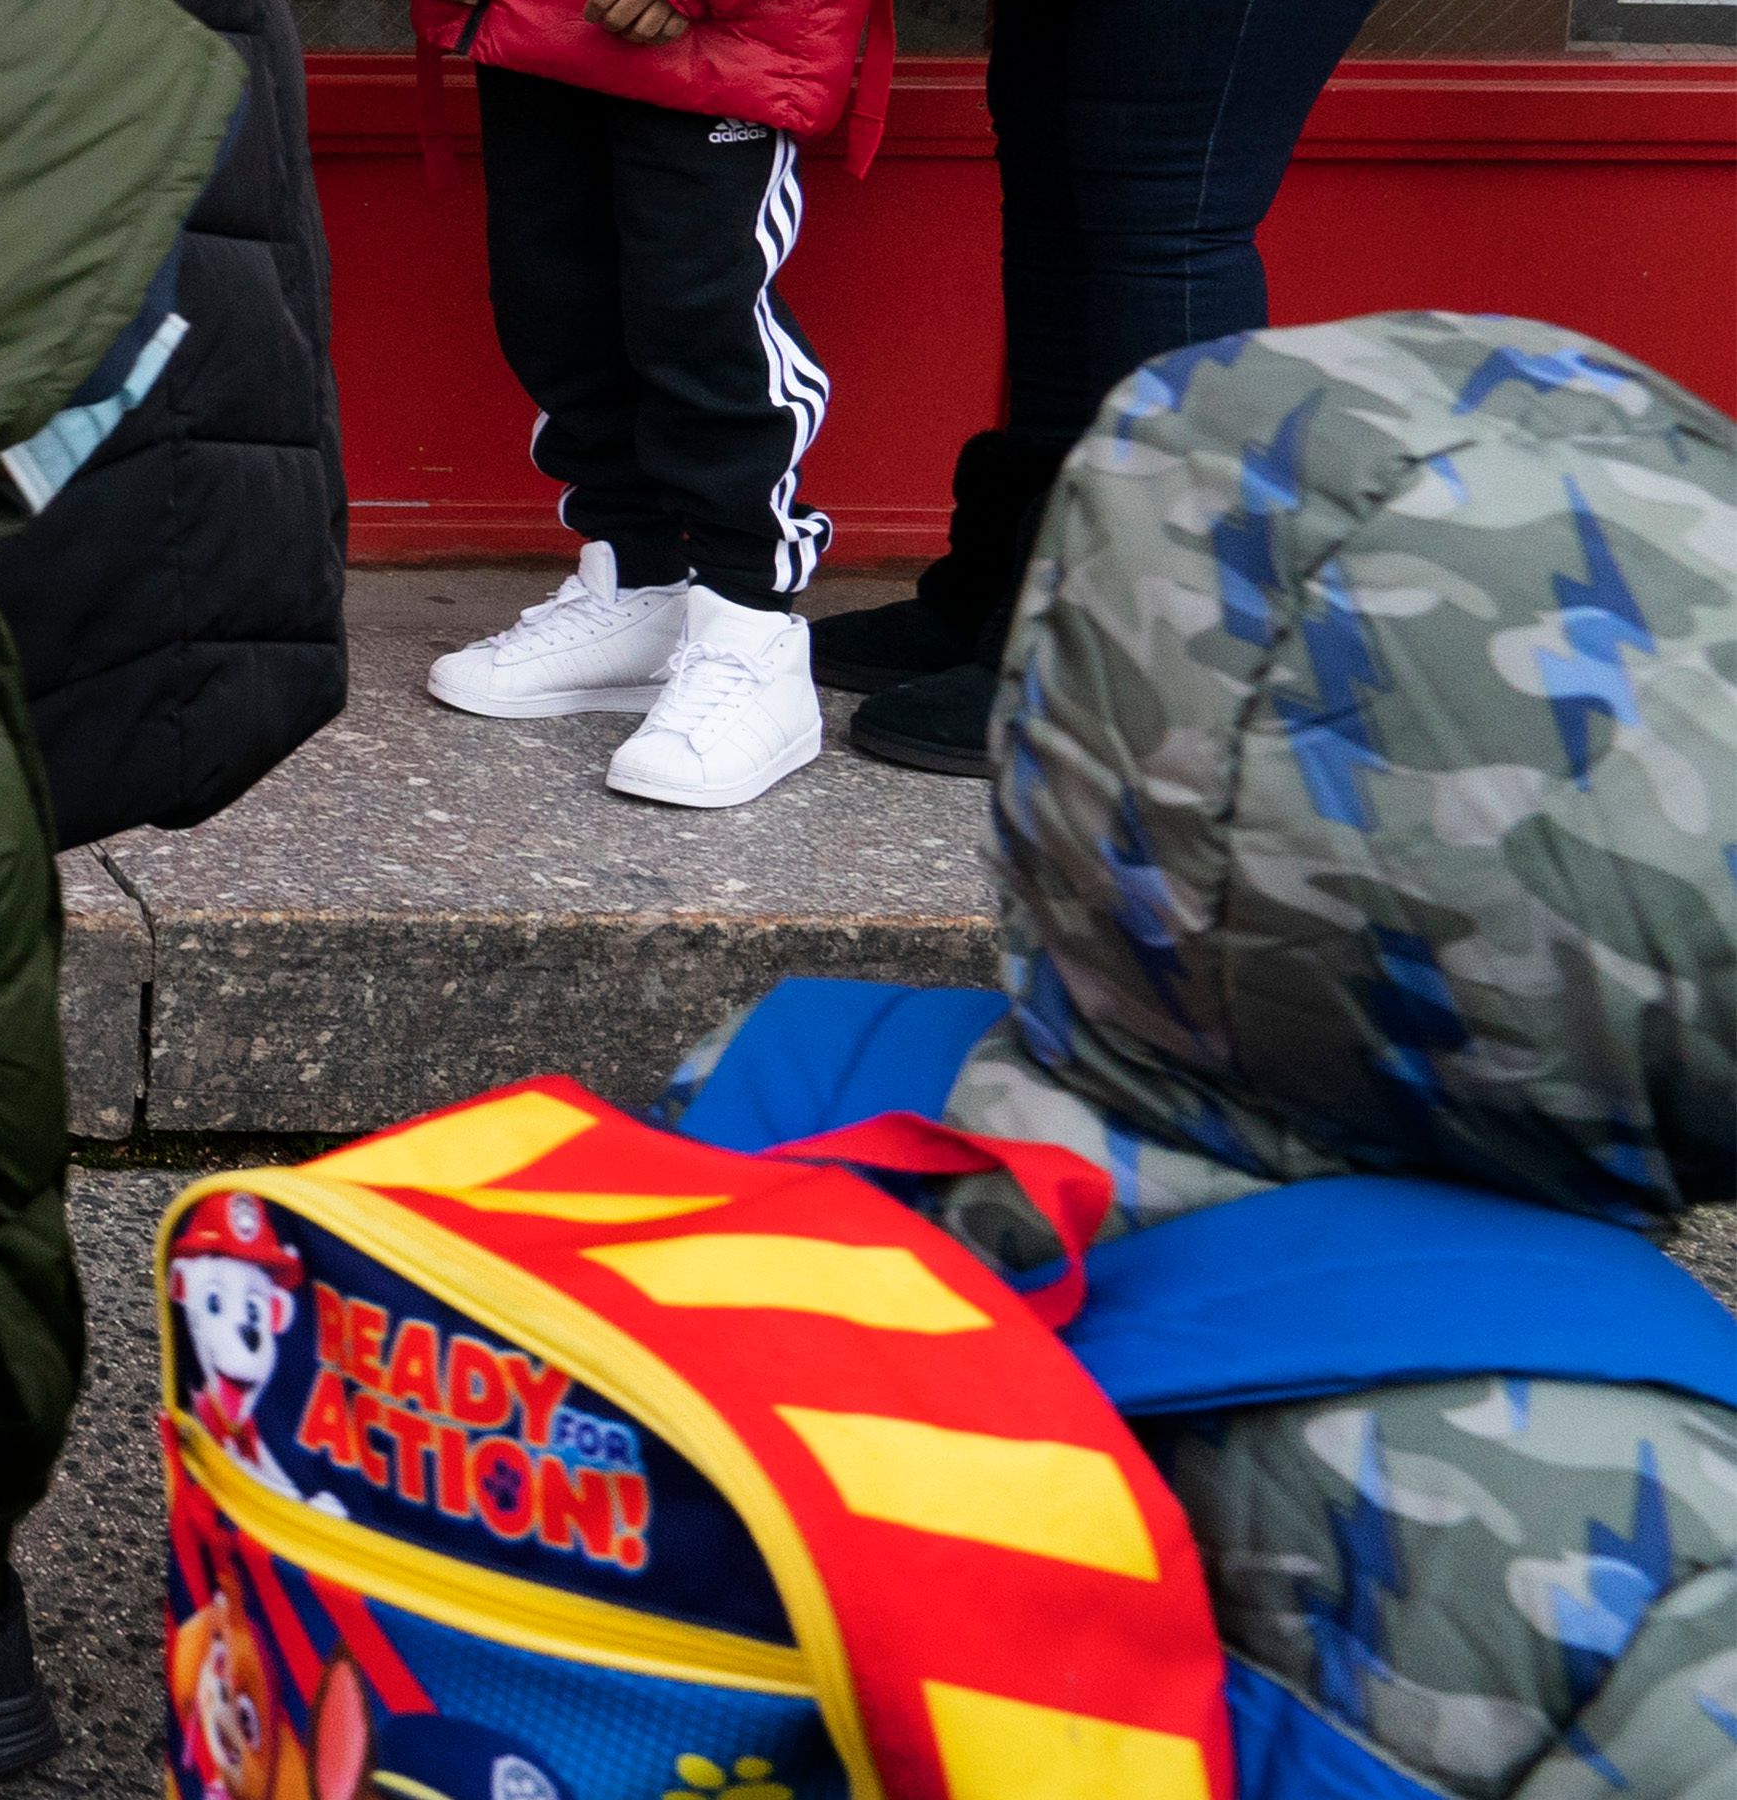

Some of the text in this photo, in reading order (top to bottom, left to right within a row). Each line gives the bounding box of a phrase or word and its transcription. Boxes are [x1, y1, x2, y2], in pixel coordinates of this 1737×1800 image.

[708, 127, 768, 144] adidas
[310, 1278, 573, 1447] READY
[296, 1370, 651, 1572] ACTION!
[555, 1407, 641, 1467] FOR
